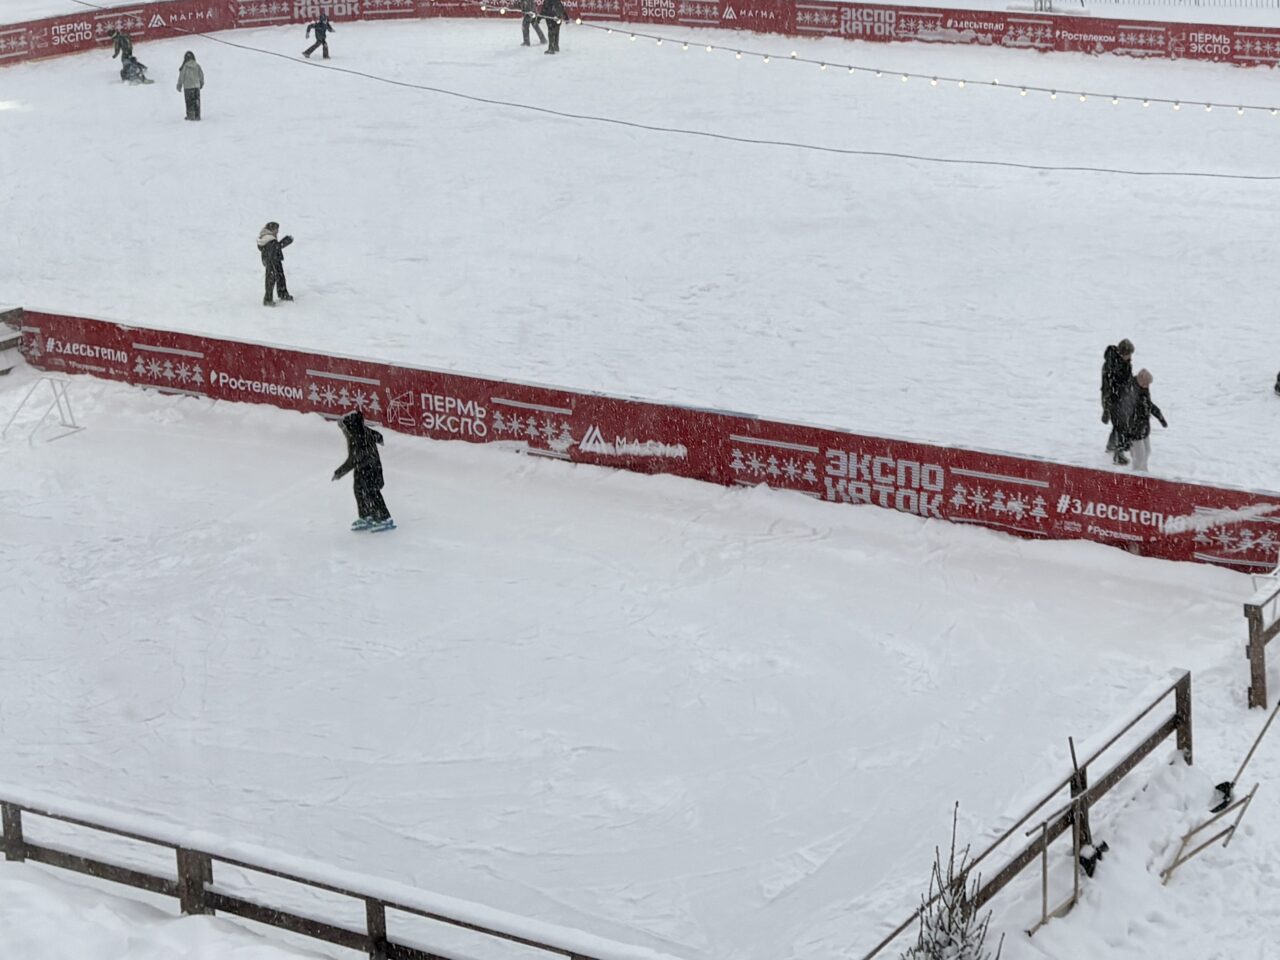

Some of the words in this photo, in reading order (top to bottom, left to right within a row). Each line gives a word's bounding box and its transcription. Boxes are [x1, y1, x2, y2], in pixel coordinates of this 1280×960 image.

[169, 10, 213, 23] МАГМА
[293, 3, 360, 19] КАТОК
[641, 7, 676, 18] ЭКСПО
[739, 10, 775, 20] МАГМА
[840, 7, 896, 24] ЭКСПО
[51, 23, 92, 36] ПЕРМЬ
[839, 21, 897, 37] КАТОК
[51, 31, 92, 46] ЭКСПО
[1061, 31, 1116, 43] Ростелеком
[1189, 32, 1231, 44] ПЕРМЬ
[1189, 42, 1231, 55] ЭКСПО
[219, 372, 303, 400] Ростелеком
[421, 393, 487, 419] ПЕРМЬ
[421, 413, 488, 437] ЭКСПО
[825, 447, 944, 491] ЭКСПО
[823, 476, 943, 519] КАТОК
